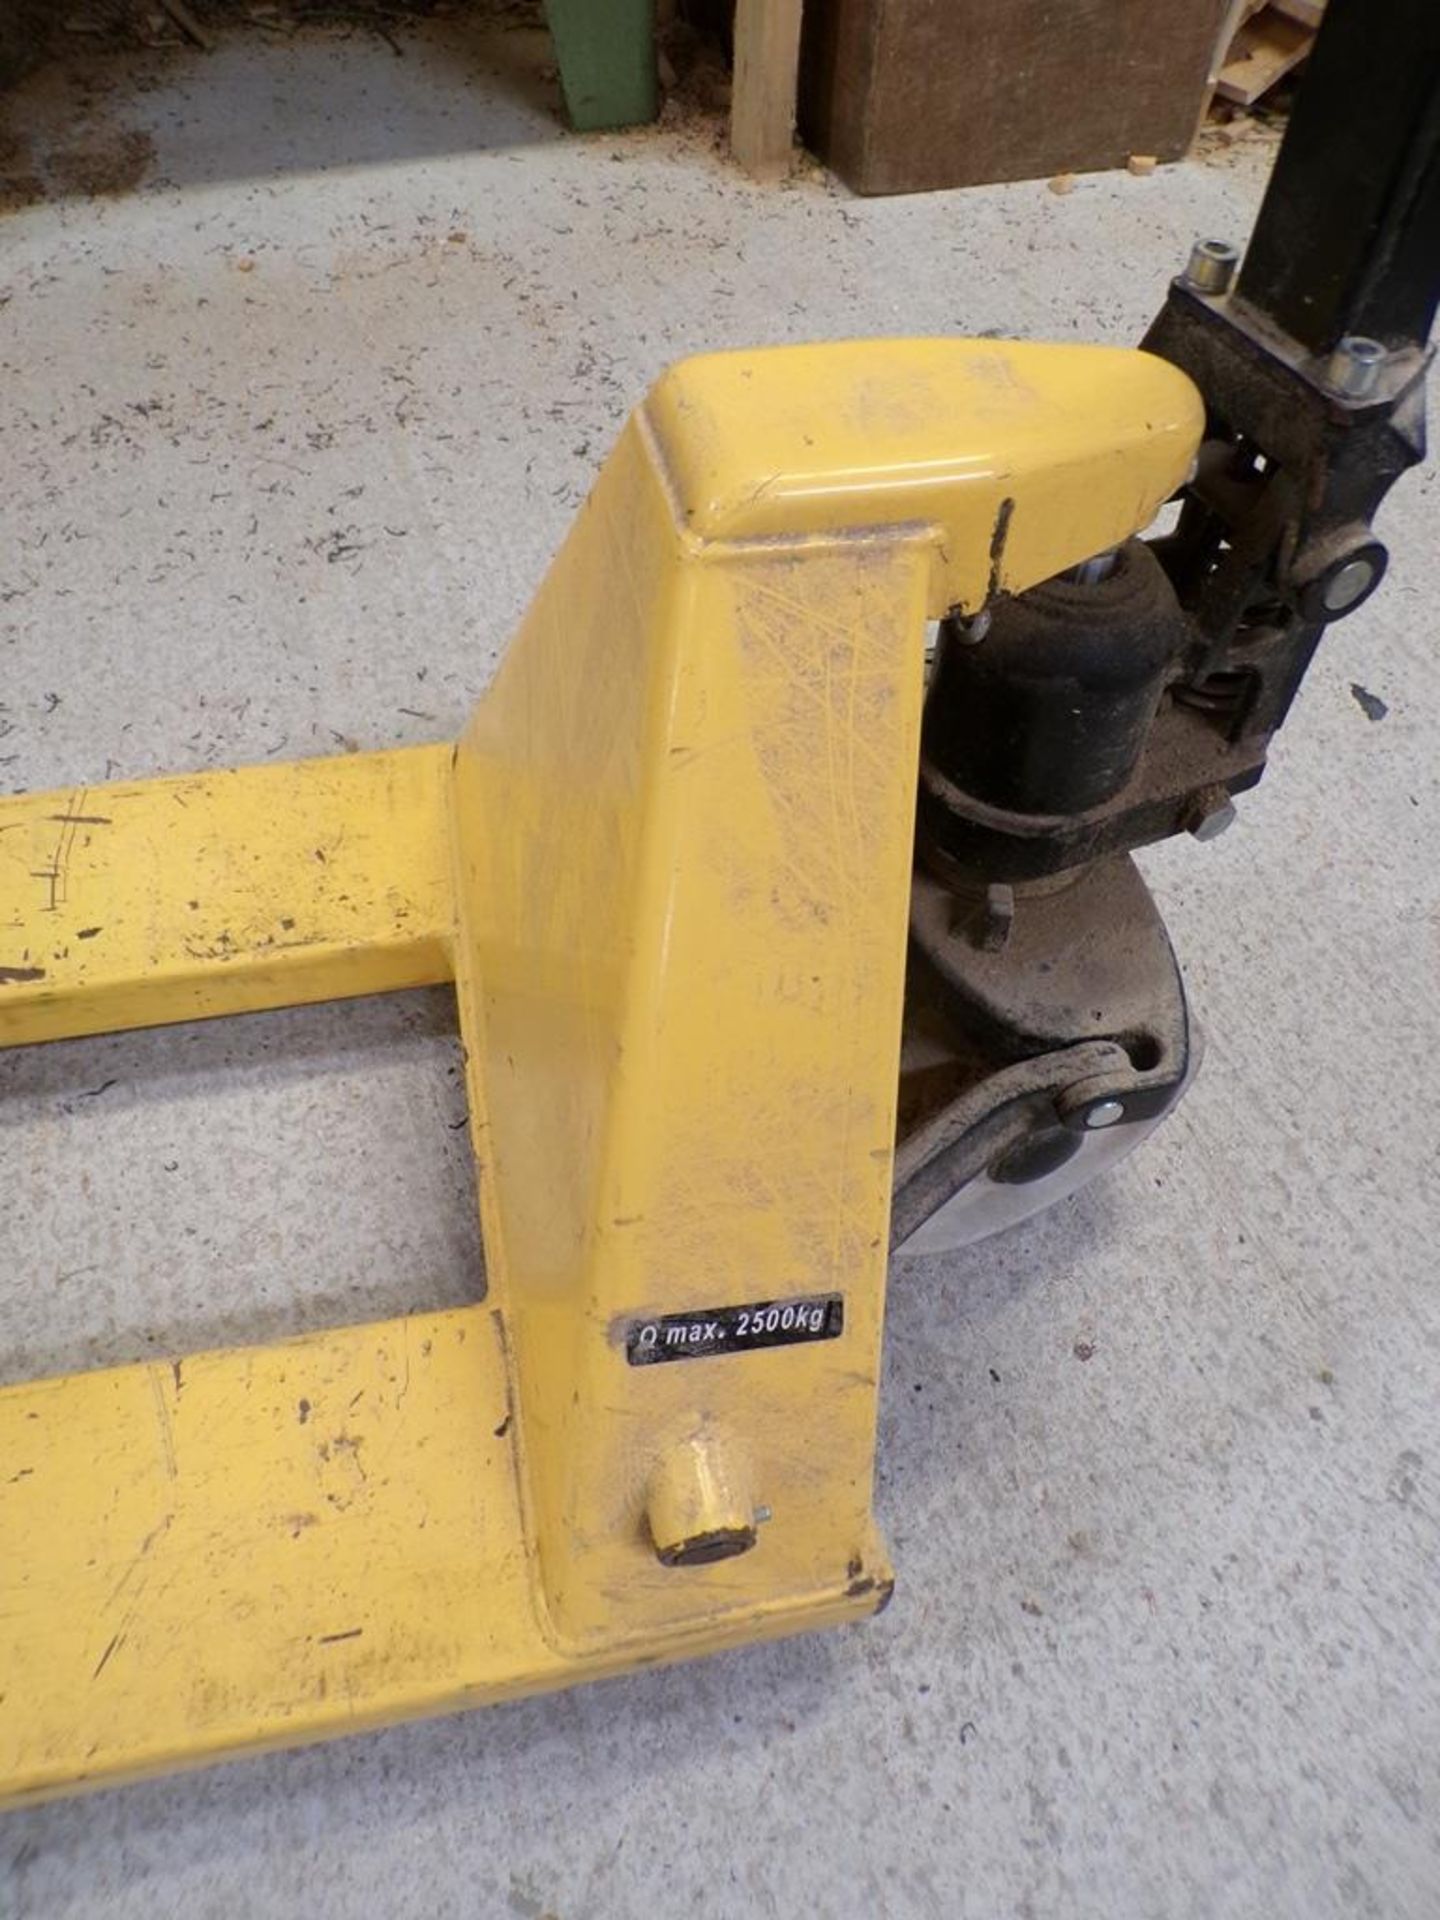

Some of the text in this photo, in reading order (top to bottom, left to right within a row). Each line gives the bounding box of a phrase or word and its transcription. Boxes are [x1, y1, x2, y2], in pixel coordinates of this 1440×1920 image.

[639, 1305, 824, 1349] Q max. 2500kg
